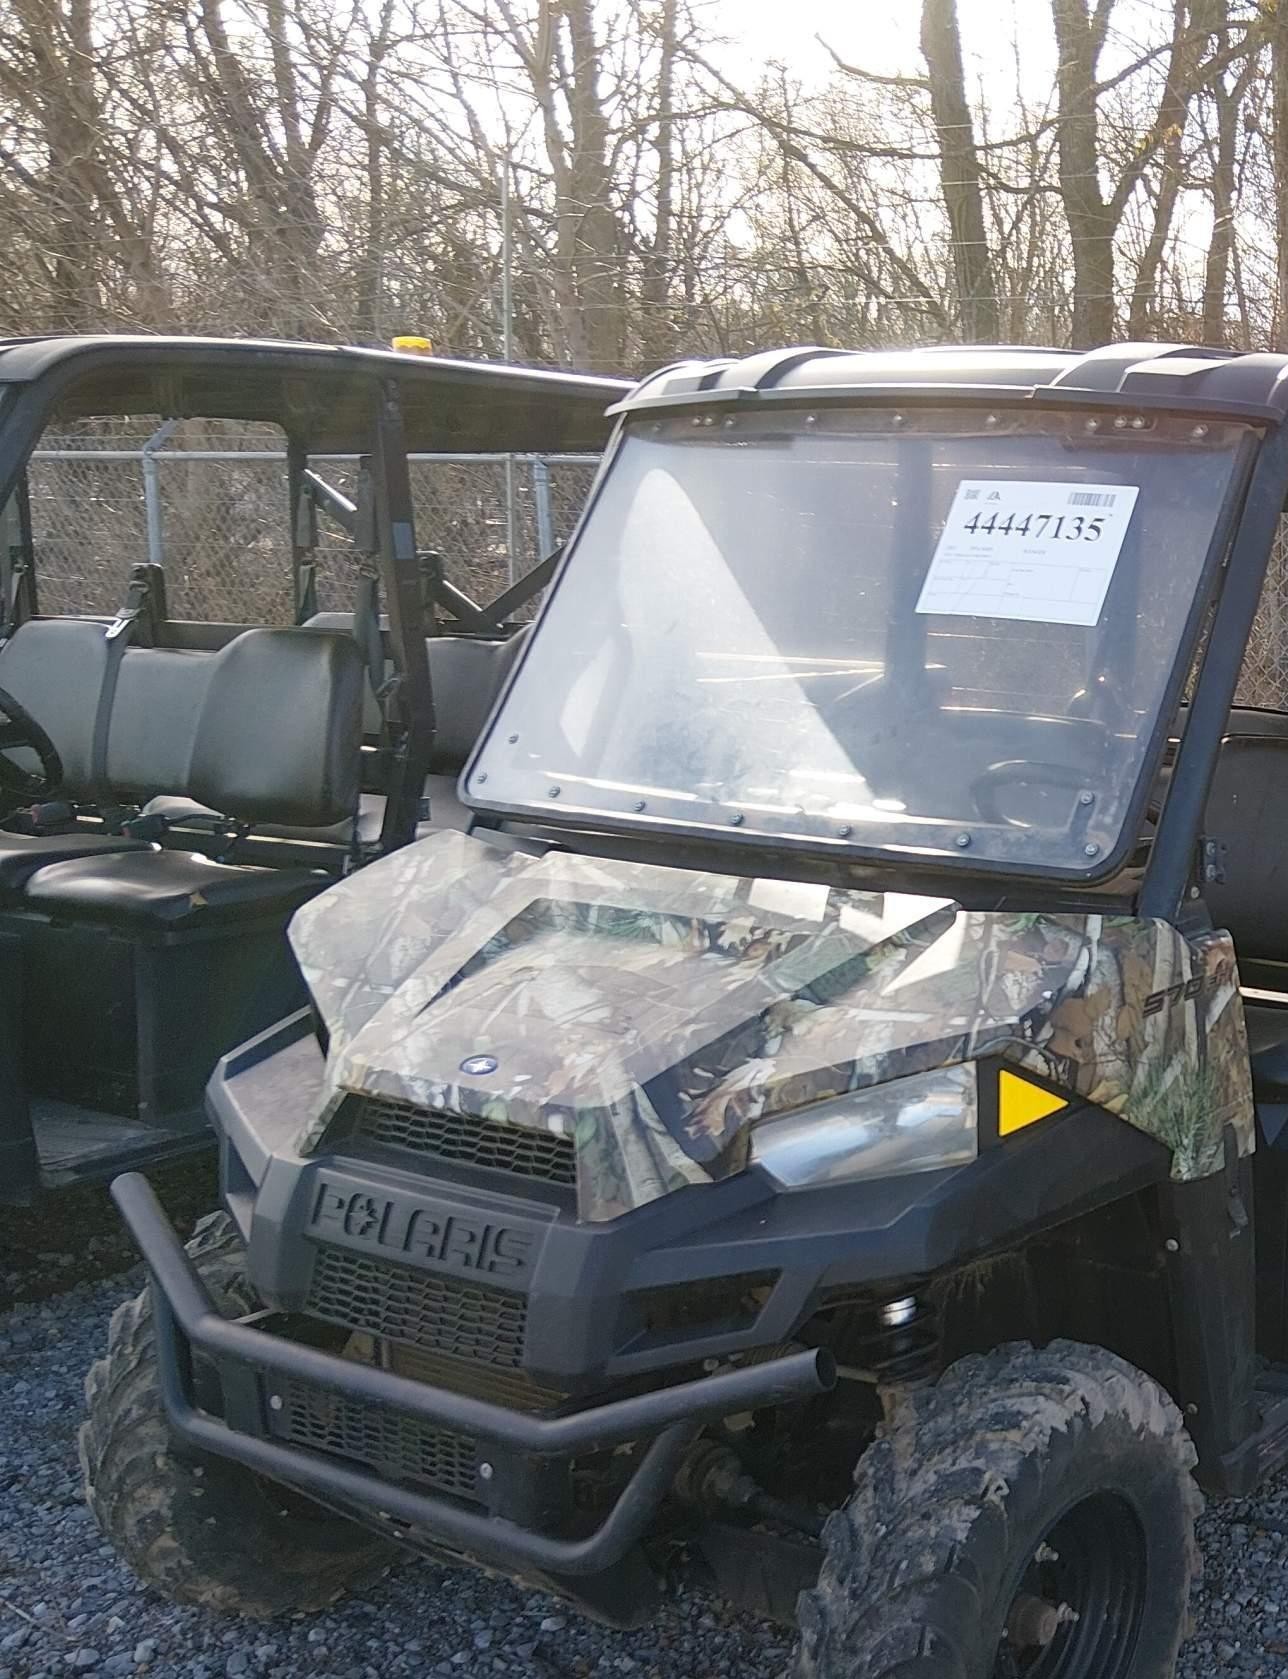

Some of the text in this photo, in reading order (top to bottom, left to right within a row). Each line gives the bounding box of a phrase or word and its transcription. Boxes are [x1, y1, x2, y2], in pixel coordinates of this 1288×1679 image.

[964, 511, 1106, 542] 44447135
[1142, 975, 1204, 1018] 570
[311, 1182, 535, 1276] POLARIS
